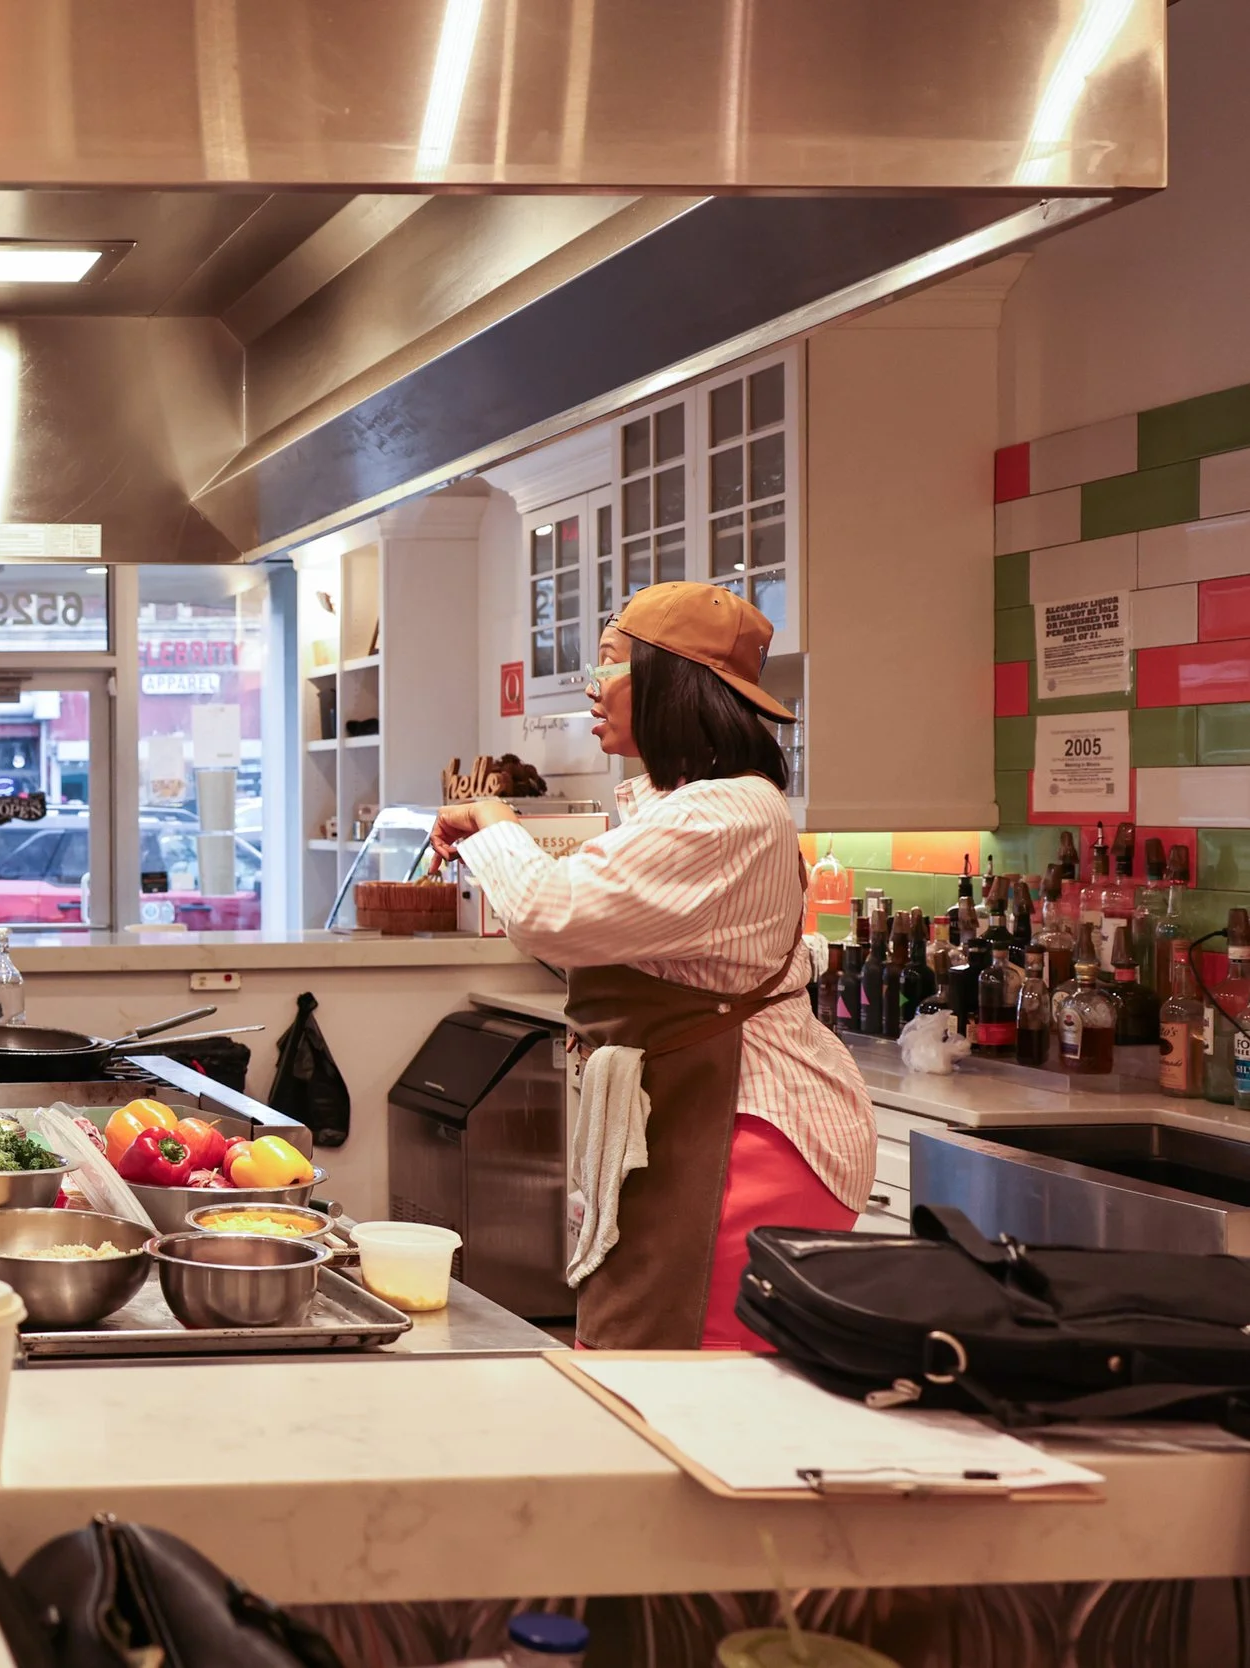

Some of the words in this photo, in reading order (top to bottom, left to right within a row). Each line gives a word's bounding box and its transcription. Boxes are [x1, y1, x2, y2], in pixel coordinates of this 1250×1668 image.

[1046, 601, 1089, 615] ALCOHOLIC
[1090, 596, 1119, 608] LIQUOR
[1046, 612, 1069, 622] SHALL
[1070, 609, 1086, 618] NOT
[1087, 608, 1097, 616] BE
[1099, 605, 1119, 614] SOLD
[1046, 622, 1058, 630] OR
[1059, 615, 1100, 628] FURNISHED
[1101, 613, 1112, 621] TO
[1113, 612, 1119, 620] A
[1046, 627, 1075, 638] PERSON
[1076, 623, 1102, 633] UNDER
[1103, 620, 1119, 630] THE
[1062, 634, 1078, 643] AGE
[1078, 632, 1089, 641] OF
[146, 676, 216, 690] APPAREL
[1065, 737, 1102, 757] 2005
[447, 756, 500, 800] hello
